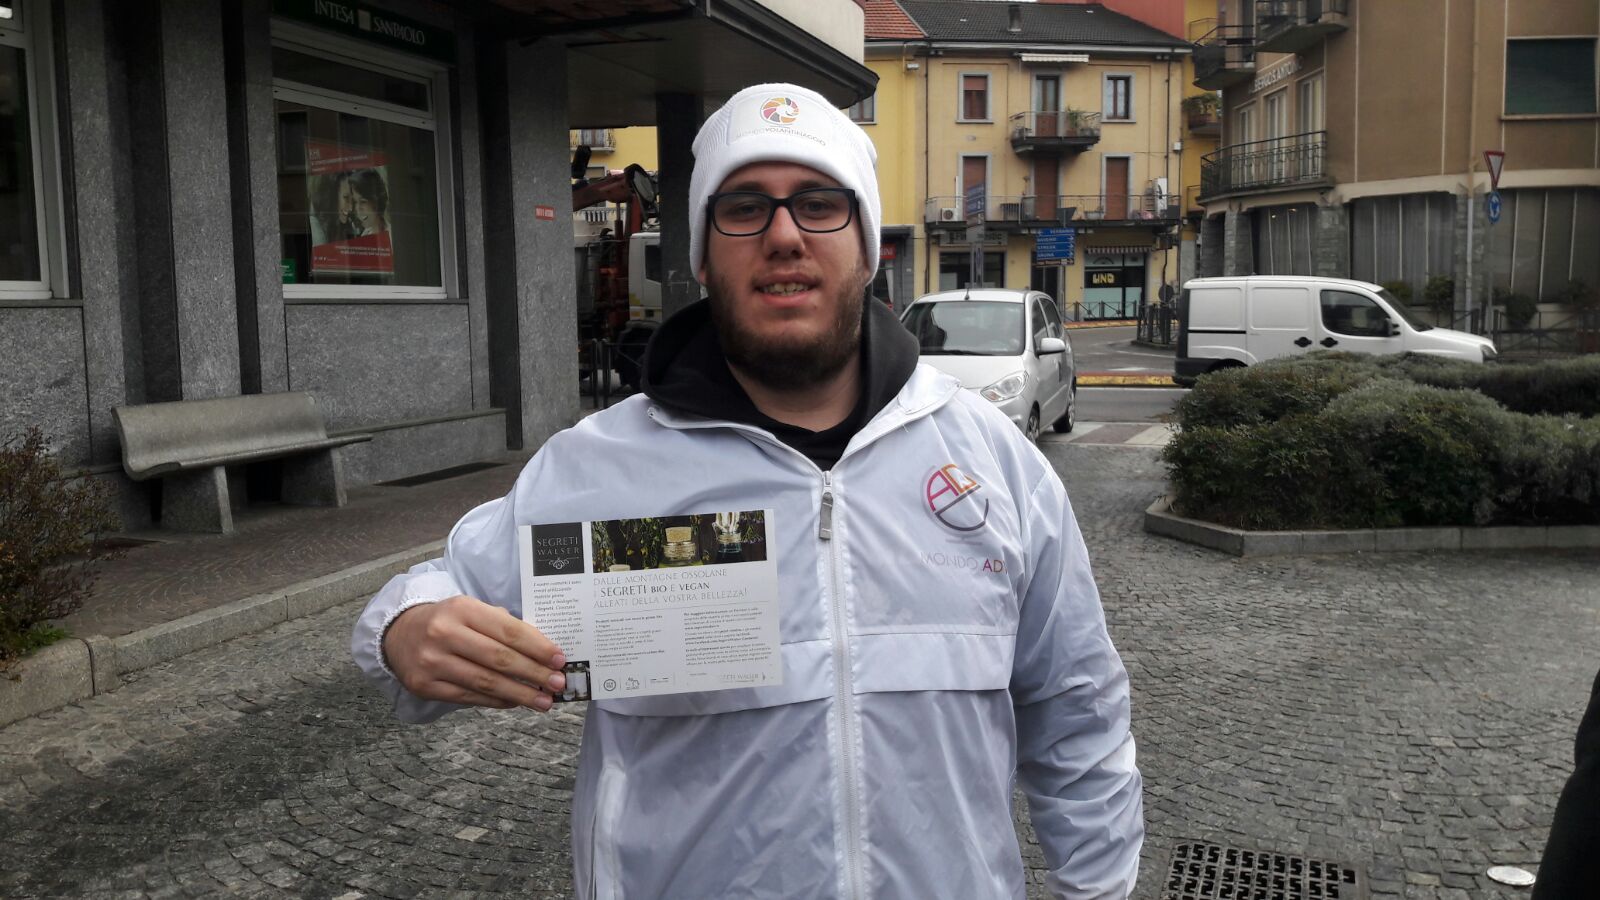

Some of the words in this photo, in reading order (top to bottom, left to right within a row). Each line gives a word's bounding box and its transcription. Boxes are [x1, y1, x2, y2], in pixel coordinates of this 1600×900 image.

[314, 0, 355, 25] INTESA
[373, 16, 425, 46] SANPAOLO
[536, 536, 578, 547] SEGRETI
[920, 551, 978, 570] MONDO
[593, 575, 621, 586] DALLE
[624, 571, 678, 584] MONTAGNE
[681, 568, 727, 580] OSSOLANE
[593, 597, 628, 609] ALLEATI
[632, 595, 659, 606] DELLA
[663, 593, 698, 603] VOSTRA
[701, 587, 748, 600] BELLEZZA!
[600, 585, 647, 598] SEGRETI
[650, 584, 668, 594] BIO
[670, 584, 676, 592] E
[679, 581, 711, 591] VEGAN
